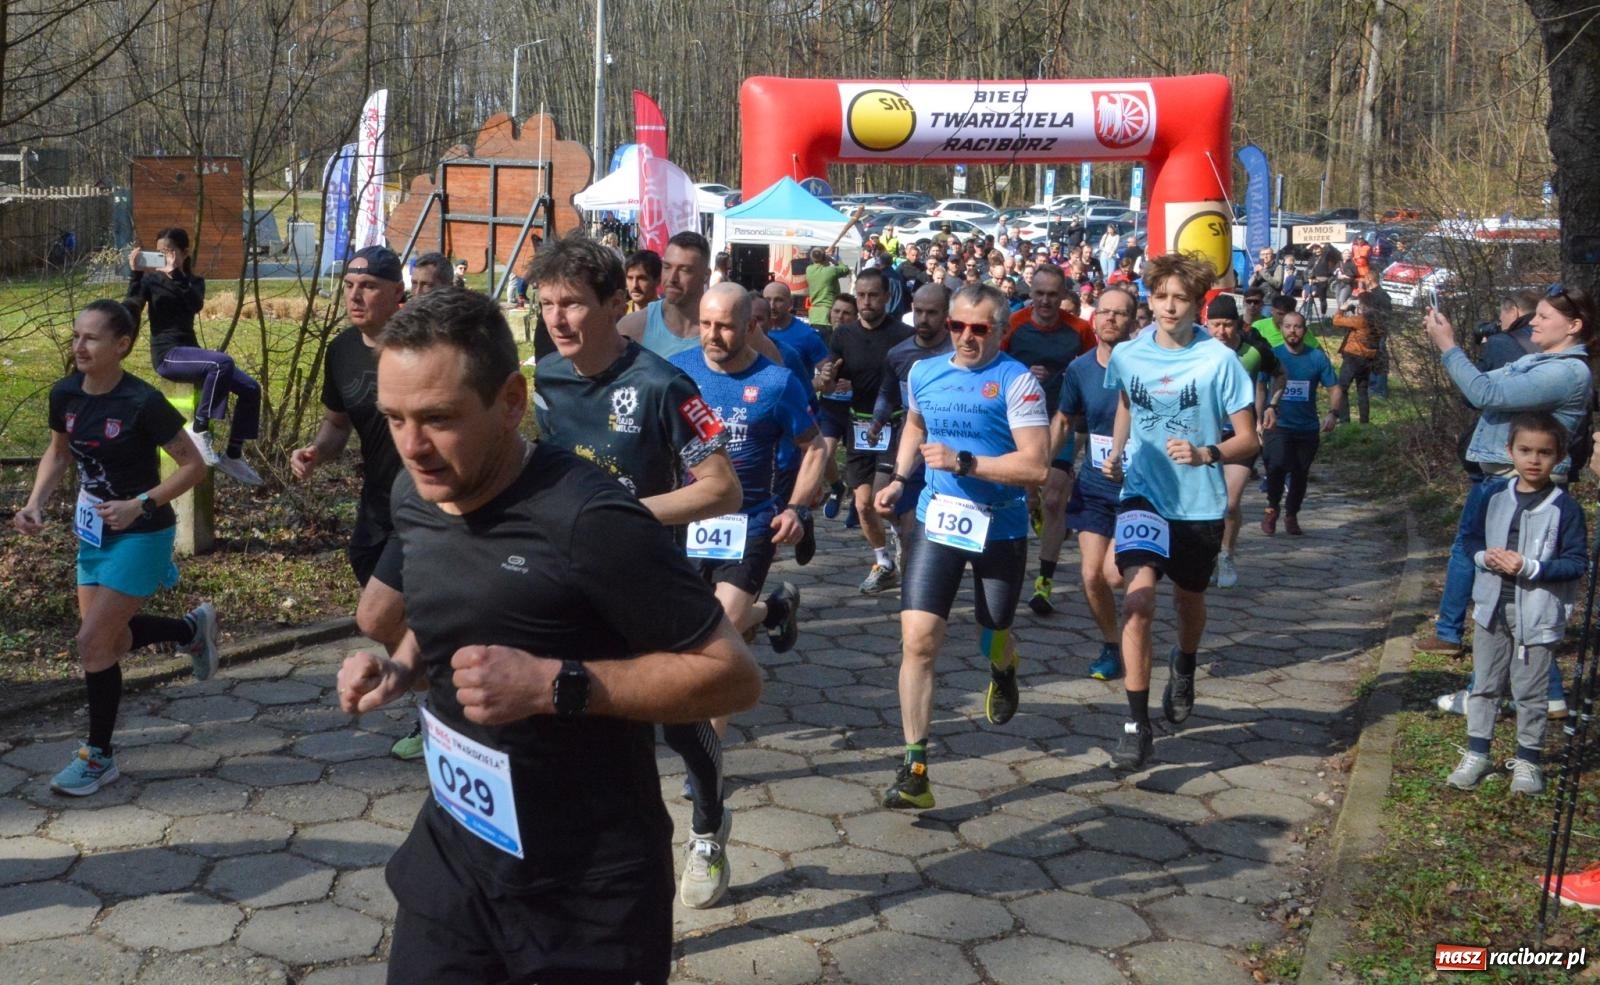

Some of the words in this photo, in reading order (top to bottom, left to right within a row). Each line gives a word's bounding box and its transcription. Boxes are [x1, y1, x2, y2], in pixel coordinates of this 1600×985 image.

[878, 97, 914, 111] SIR
[974, 90, 1026, 103] BIEG
[930, 112, 1074, 128] TWARDZIELA
[943, 133, 1058, 151] RACIBÓRZ
[1302, 226, 1334, 234] VAMOS
[933, 418, 972, 429] TEAM
[80, 506, 93, 530] 112
[937, 511, 973, 535] 130
[695, 527, 732, 547] 041
[1123, 524, 1161, 541] 007
[438, 754, 495, 817] 029
